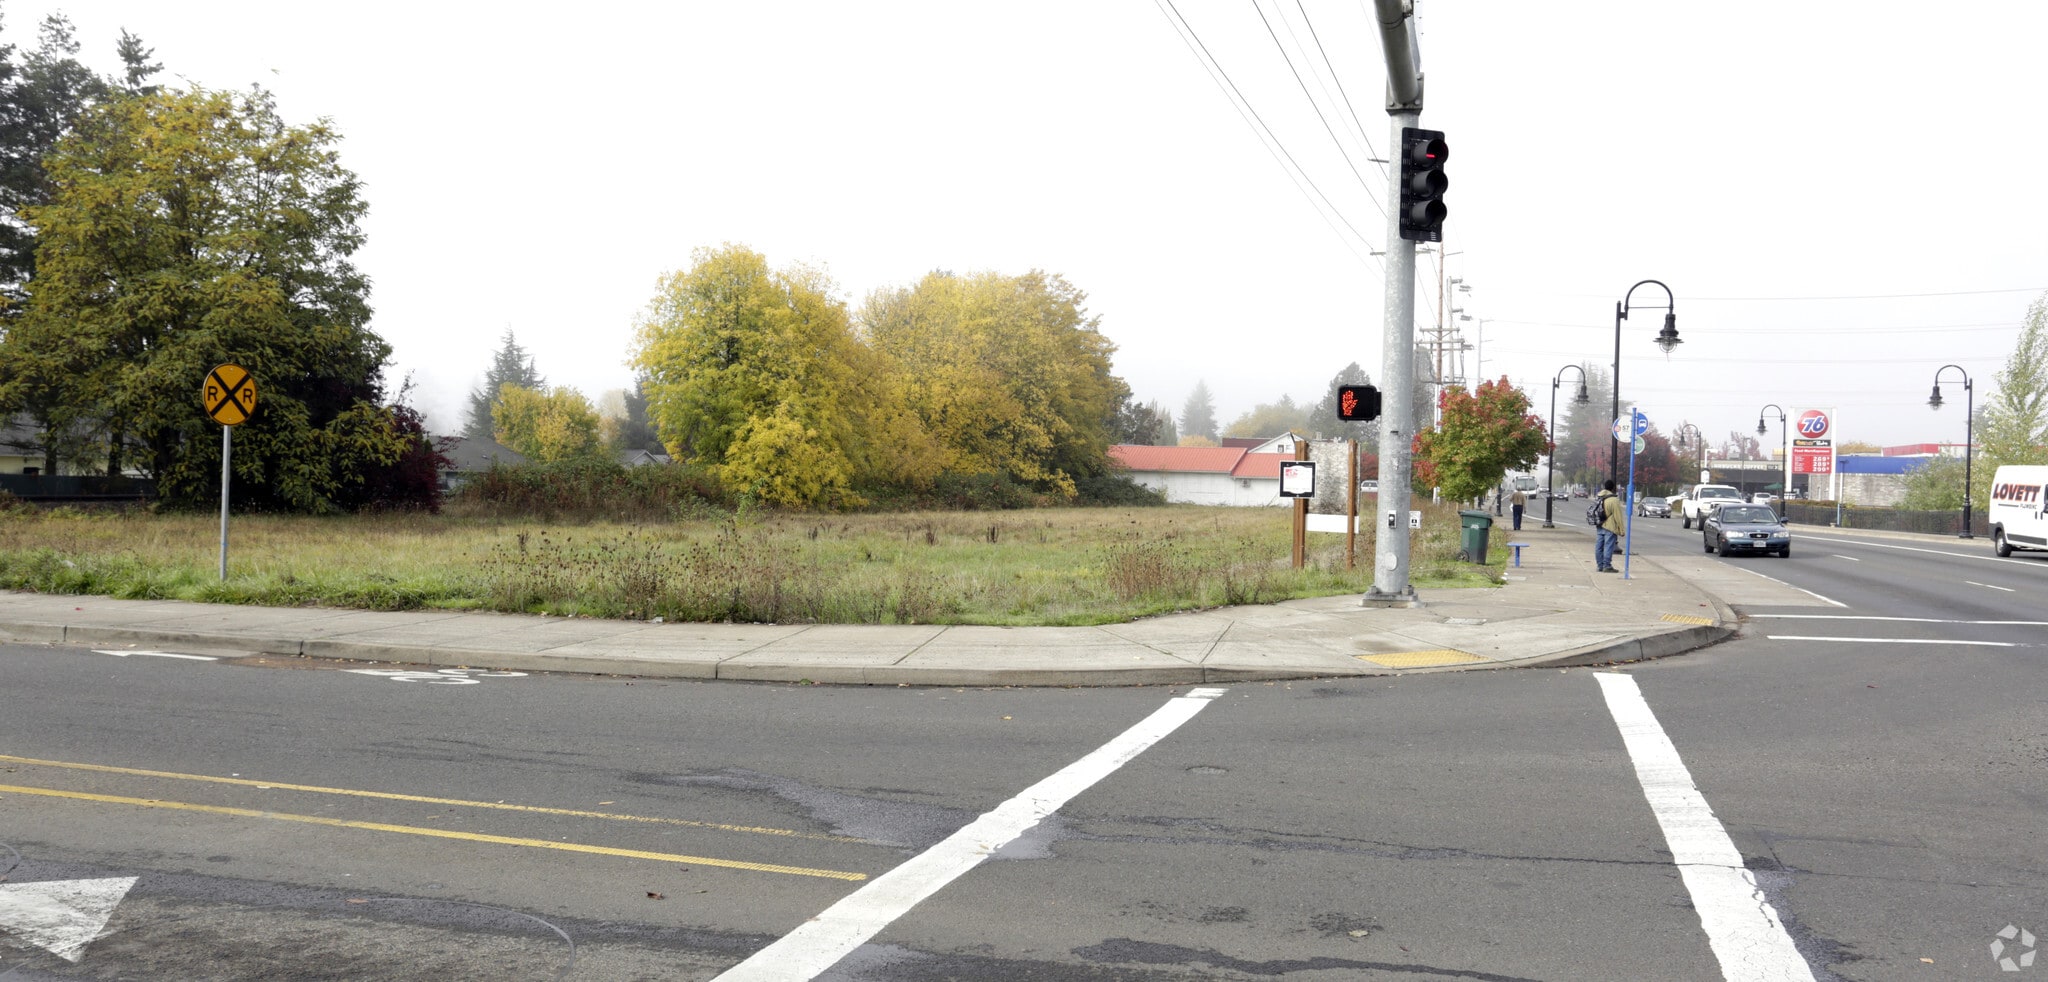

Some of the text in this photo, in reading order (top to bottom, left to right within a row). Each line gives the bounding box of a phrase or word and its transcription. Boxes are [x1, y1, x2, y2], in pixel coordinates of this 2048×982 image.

[207, 386, 253, 404] R R
[1802, 416, 1825, 432] 76
[1992, 483, 2041, 502] LOVETT
